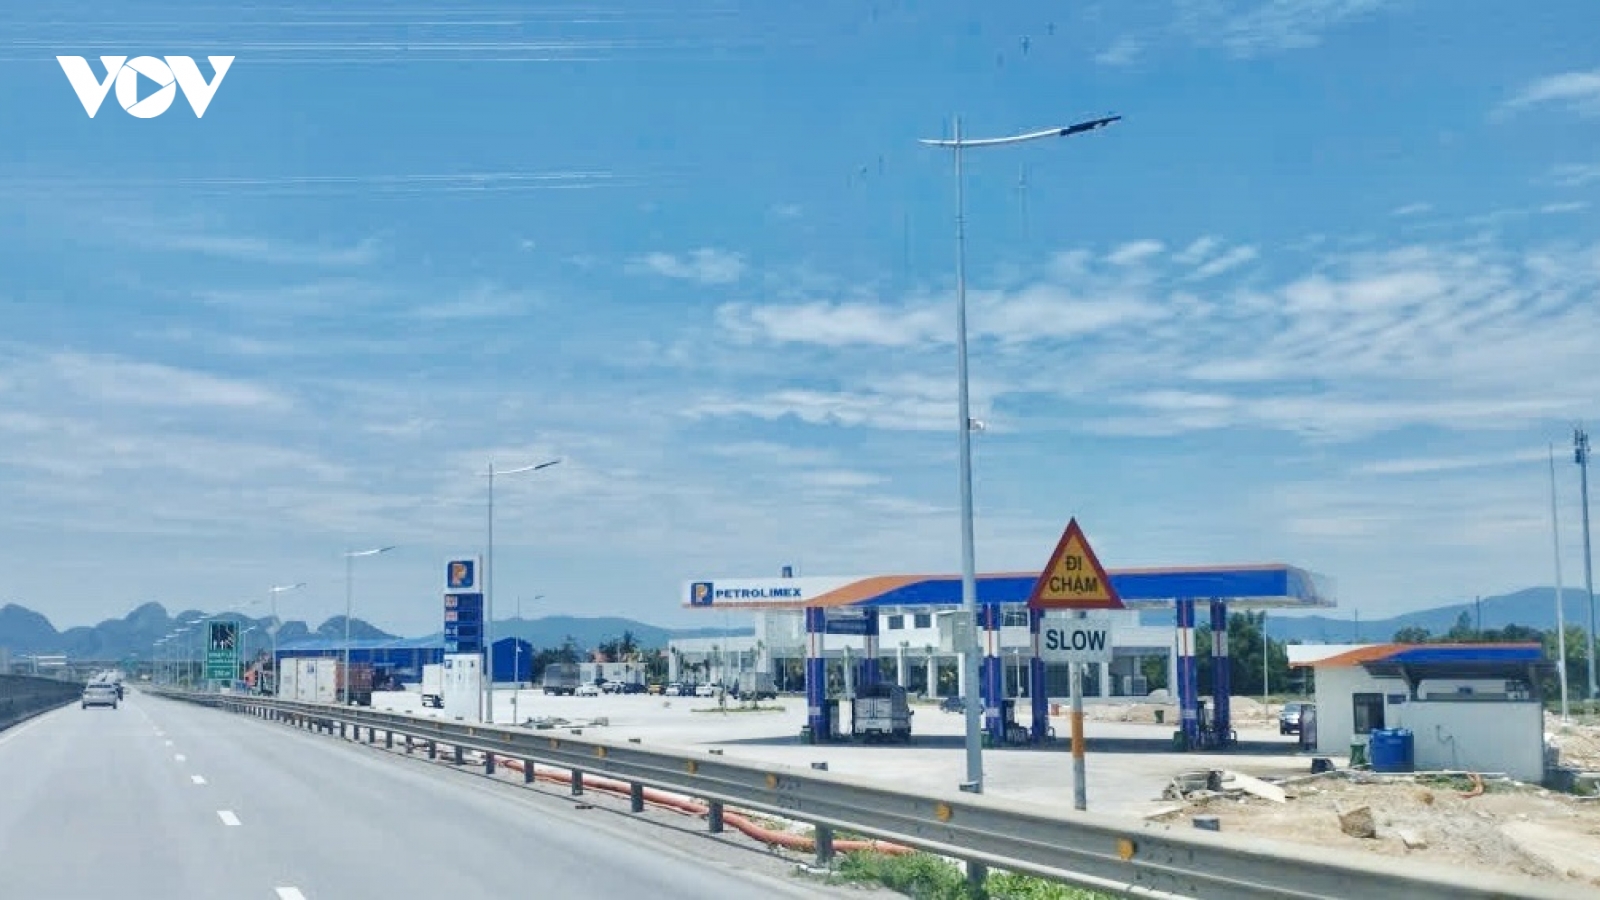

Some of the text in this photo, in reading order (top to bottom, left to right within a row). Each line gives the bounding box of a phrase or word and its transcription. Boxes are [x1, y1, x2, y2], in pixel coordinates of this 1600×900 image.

[1065, 556, 1082, 571] ĐI
[715, 588, 802, 599] PETROLIMEX
[1045, 629, 1107, 651] SLOW
